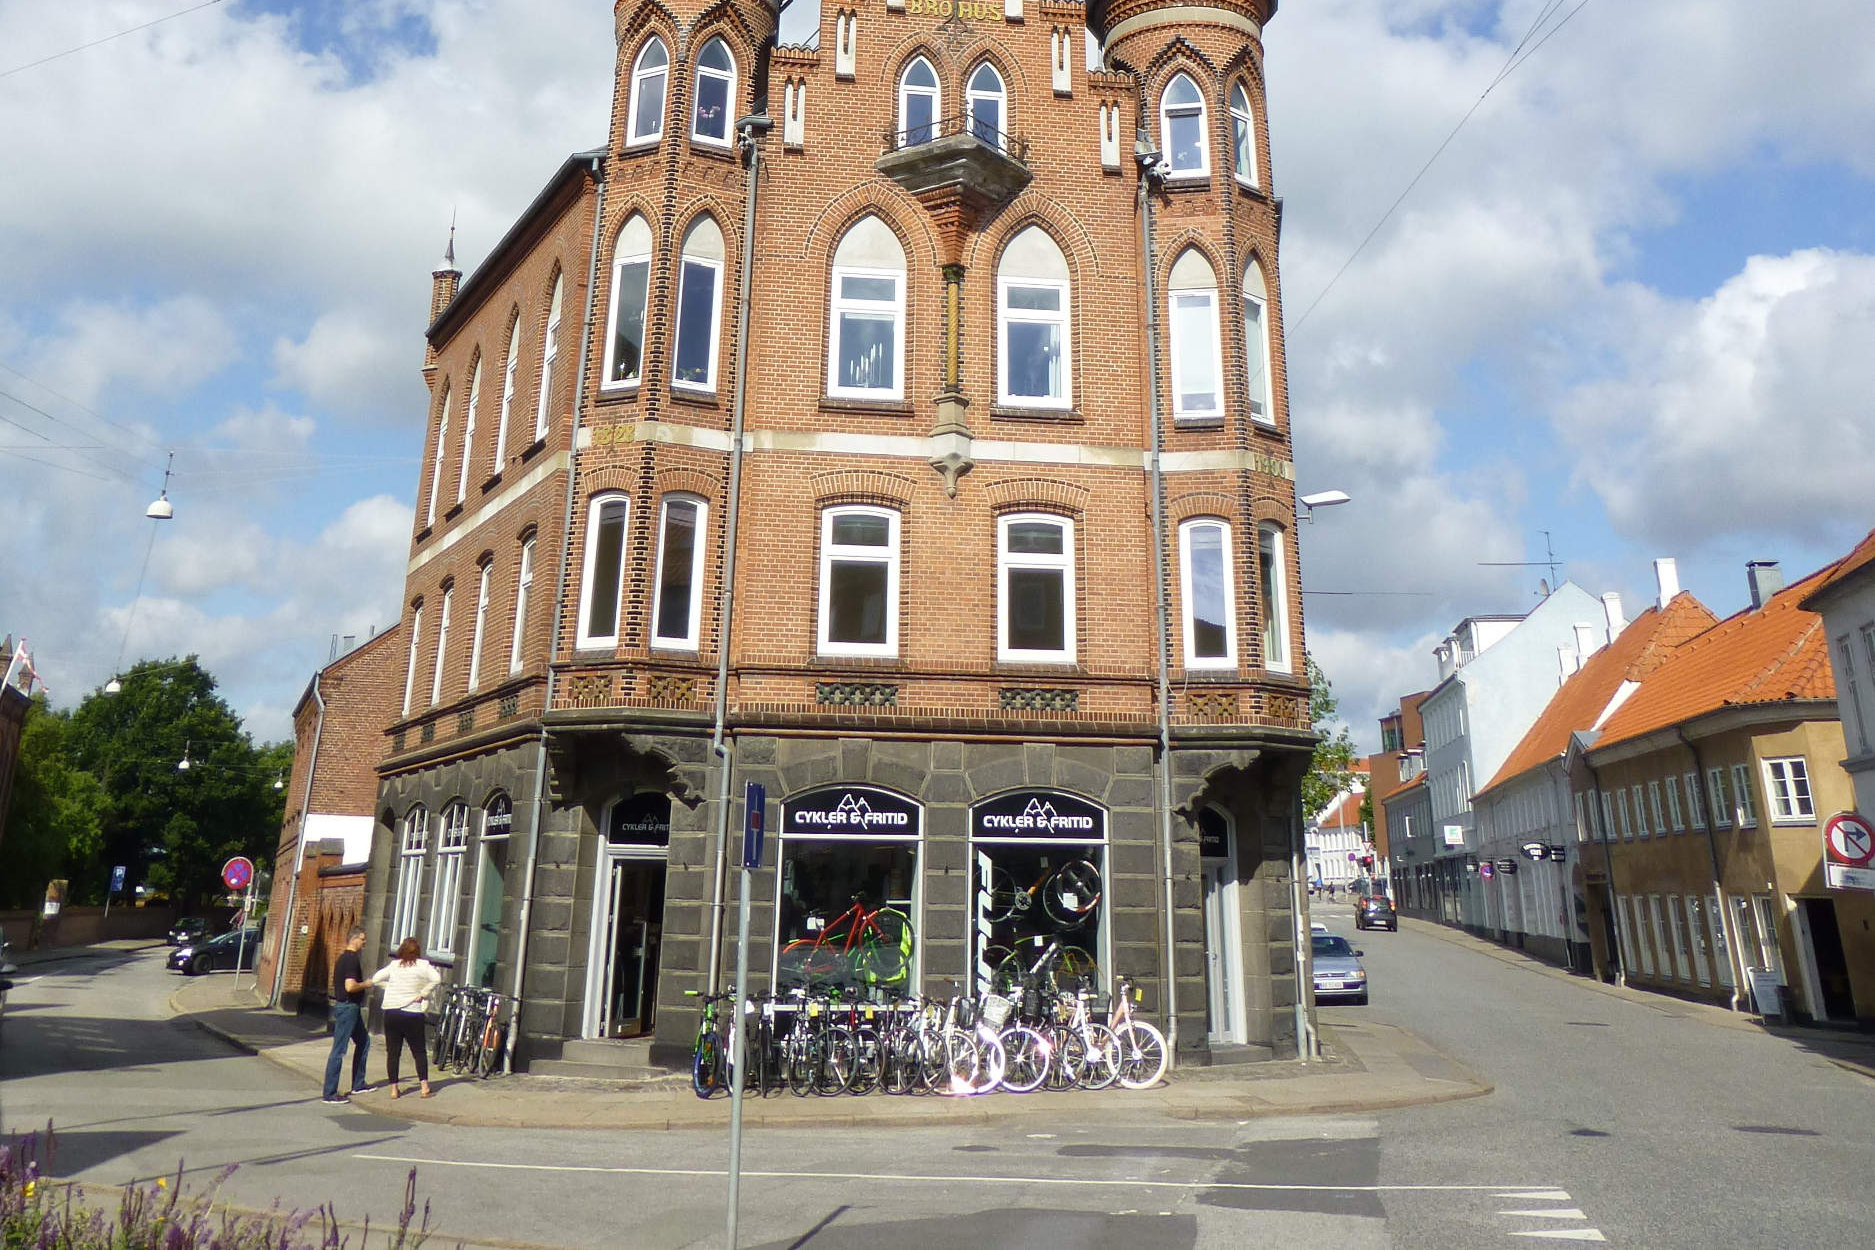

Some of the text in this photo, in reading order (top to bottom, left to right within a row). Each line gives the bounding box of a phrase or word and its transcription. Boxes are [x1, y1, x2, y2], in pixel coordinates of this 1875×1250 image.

[795, 811, 908, 825] CYKLER & FRITID
[983, 815, 1093, 829] CYKLER & FRITID
